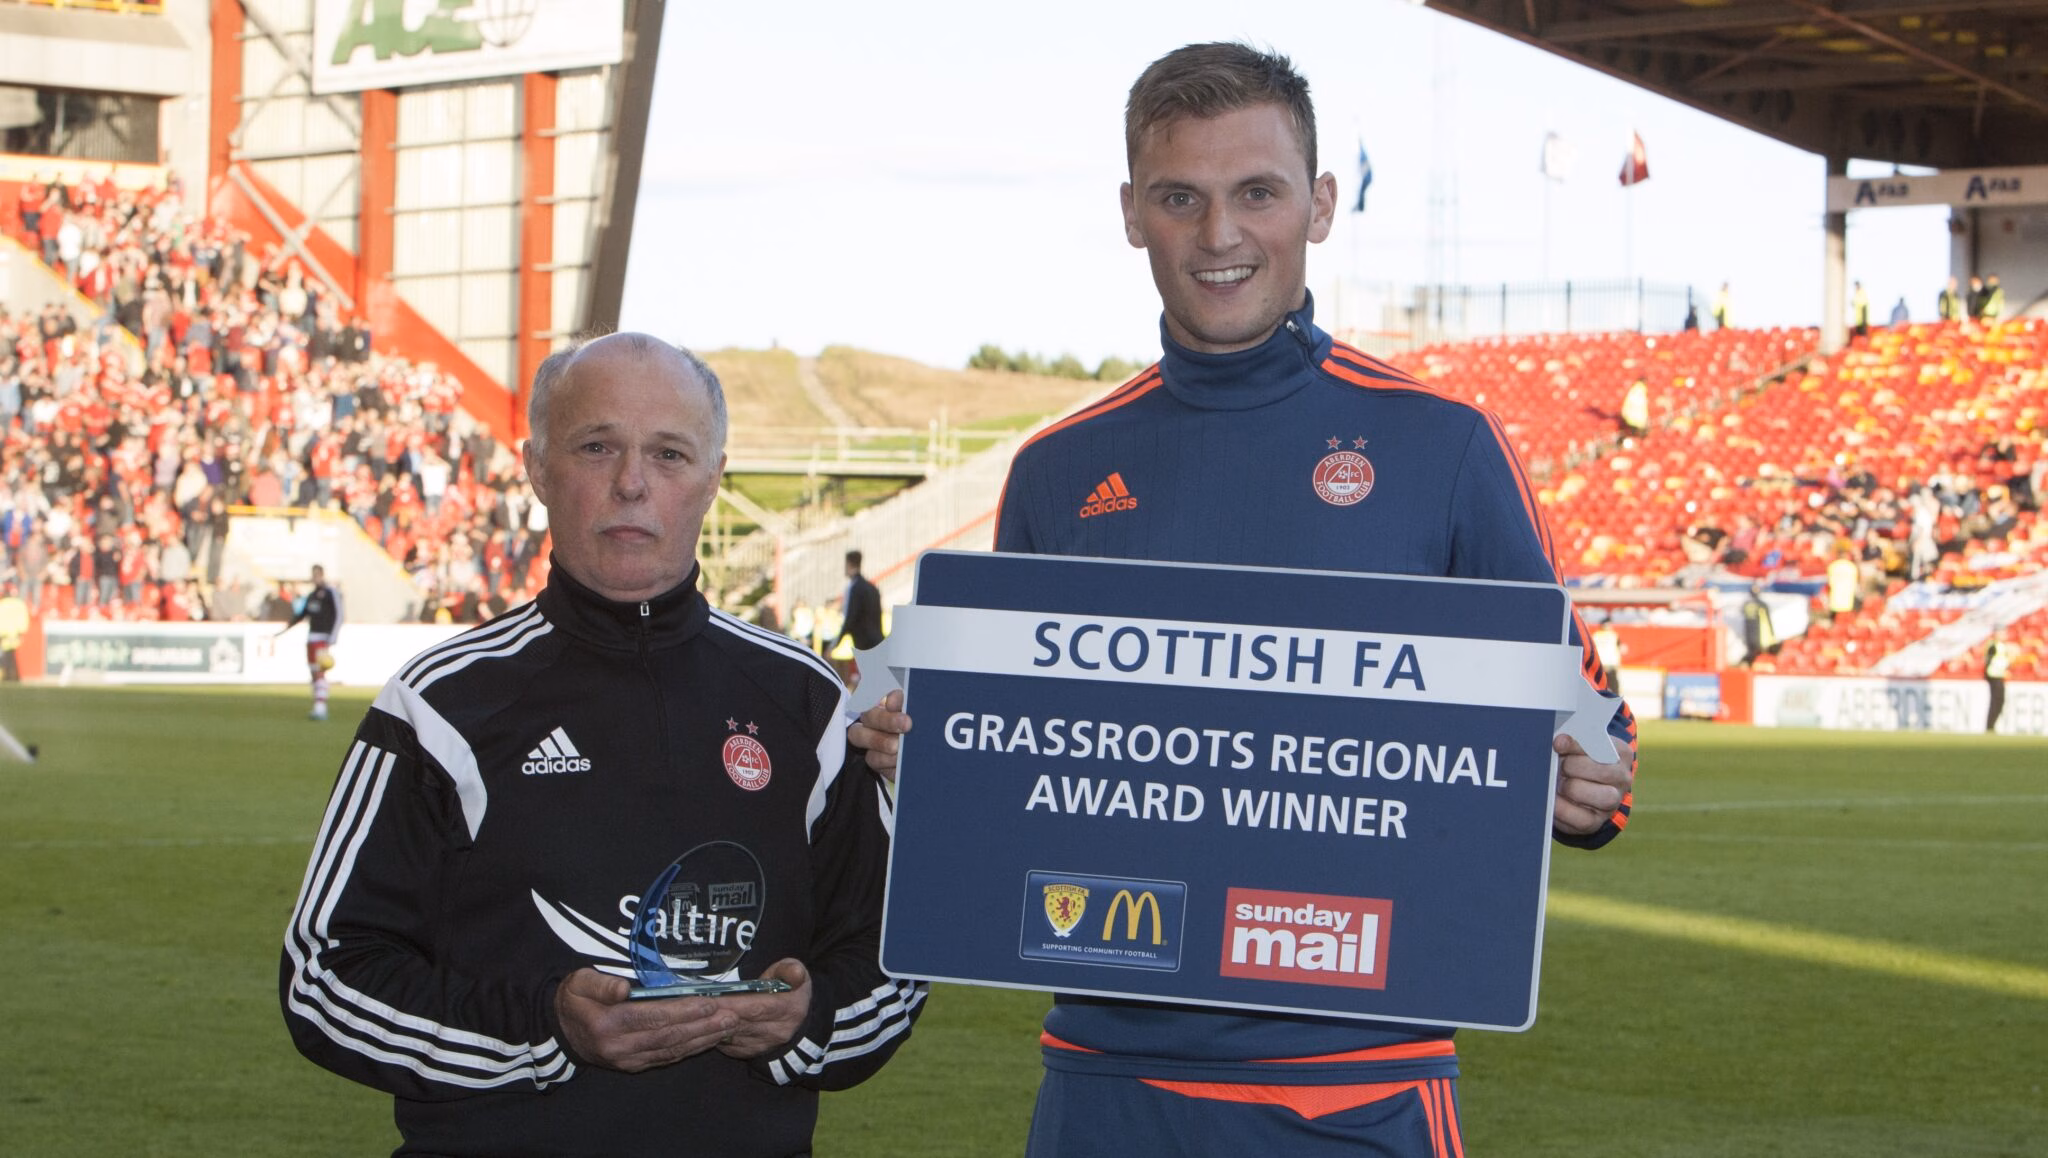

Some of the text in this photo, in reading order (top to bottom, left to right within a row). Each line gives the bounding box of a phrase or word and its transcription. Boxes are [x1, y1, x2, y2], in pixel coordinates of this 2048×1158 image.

[1324, 454, 1366, 467] ABERDEEN
[1316, 481, 1371, 503] FOOTBALL CLUB
[1080, 496, 1137, 518] adidas
[1033, 621, 1427, 692] SCOTTISH FA
[729, 738, 762, 753] ABERDEEN
[945, 712, 1508, 788] GRASSROOTS REGIONAL
[522, 756, 591, 775] adidas
[727, 762, 769, 788] FOOTBALL CLUB
[1026, 774, 1408, 839] AWARD WINNER
[618, 895, 756, 951] Saltire
[1235, 903, 1352, 933] sunday
[1042, 943, 1158, 959] SUPPORTING COMMUNITY FOOTBALL
[1232, 913, 1379, 975] mail
